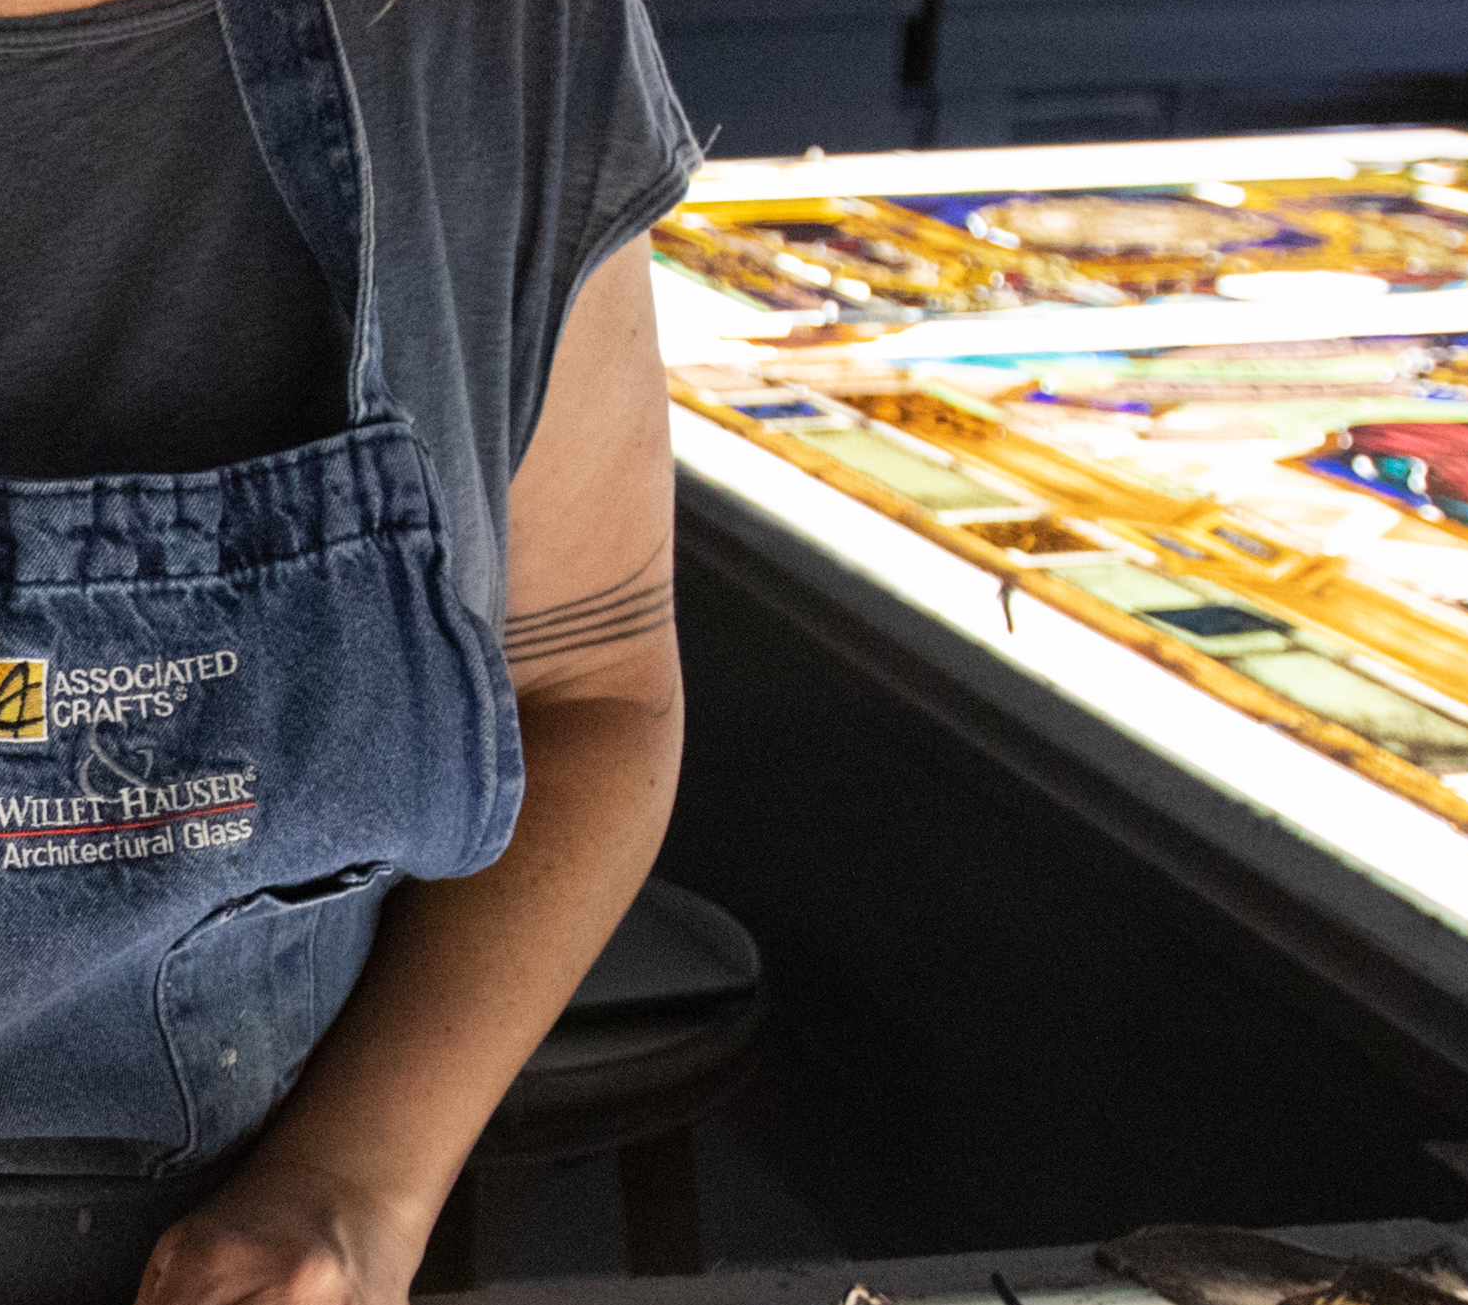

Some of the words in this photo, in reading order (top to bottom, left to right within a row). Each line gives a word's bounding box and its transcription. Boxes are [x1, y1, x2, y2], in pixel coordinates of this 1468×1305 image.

[52, 650, 239, 697] ASSOCIATED
[51, 690, 175, 728] CRAFTS
[118, 771, 255, 821] HAUSER
[2, 826, 175, 870] Architectural
[182, 817, 254, 850] Glass
